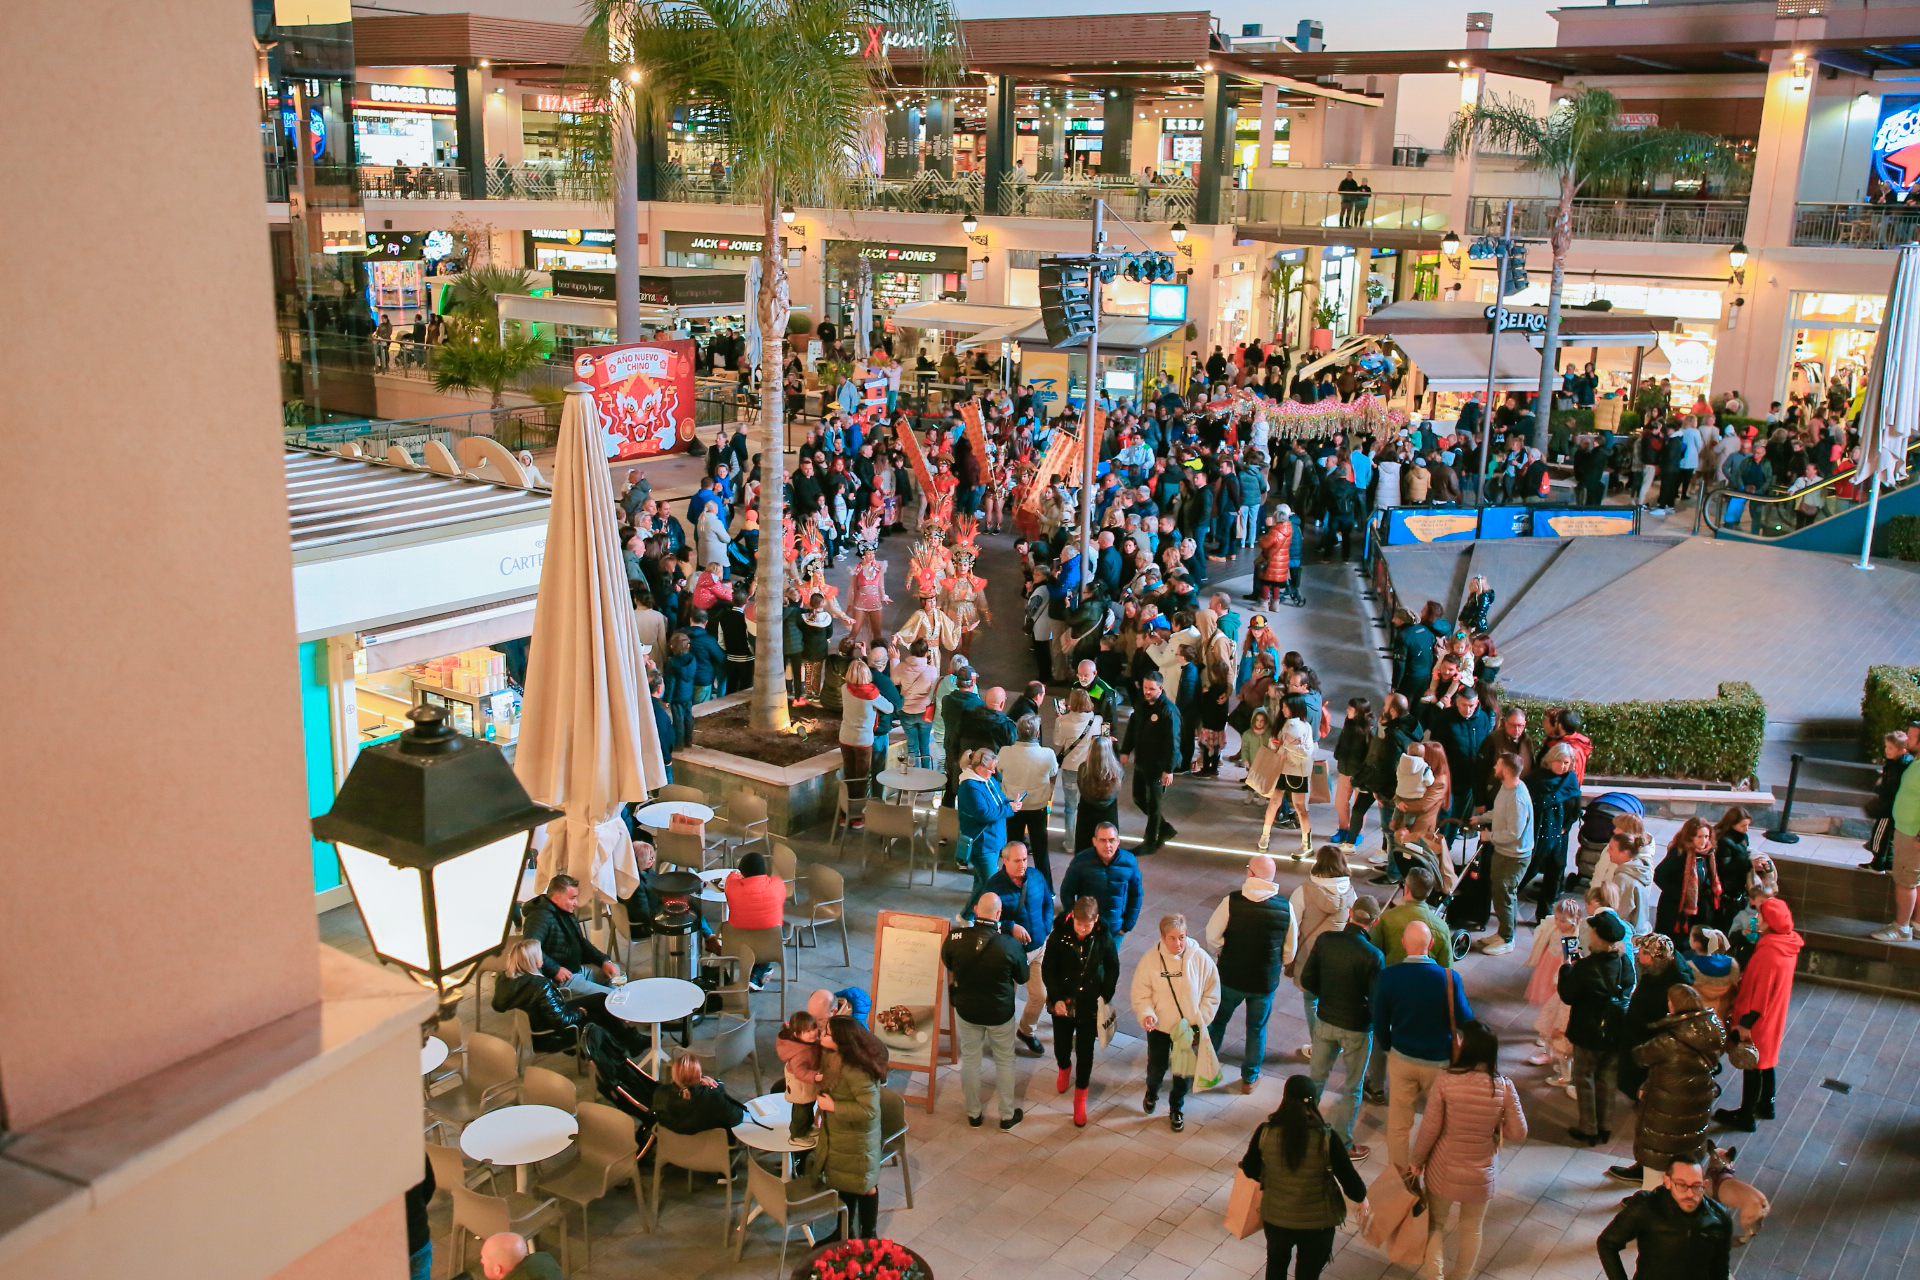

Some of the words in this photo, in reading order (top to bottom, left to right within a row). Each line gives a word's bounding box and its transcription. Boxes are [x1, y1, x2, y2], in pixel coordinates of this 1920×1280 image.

[370, 85, 427, 104] BURGER
[428, 89, 457, 106] KIN
[691, 238, 719, 249] JACK
[728, 240, 763, 252] JONES
[898, 250, 937, 262] JONES
[617, 354, 633, 365] AÑO
[635, 353, 659, 361] NUEVO
[627, 362, 650, 372] CHINO
[951, 932, 963, 940] HH
